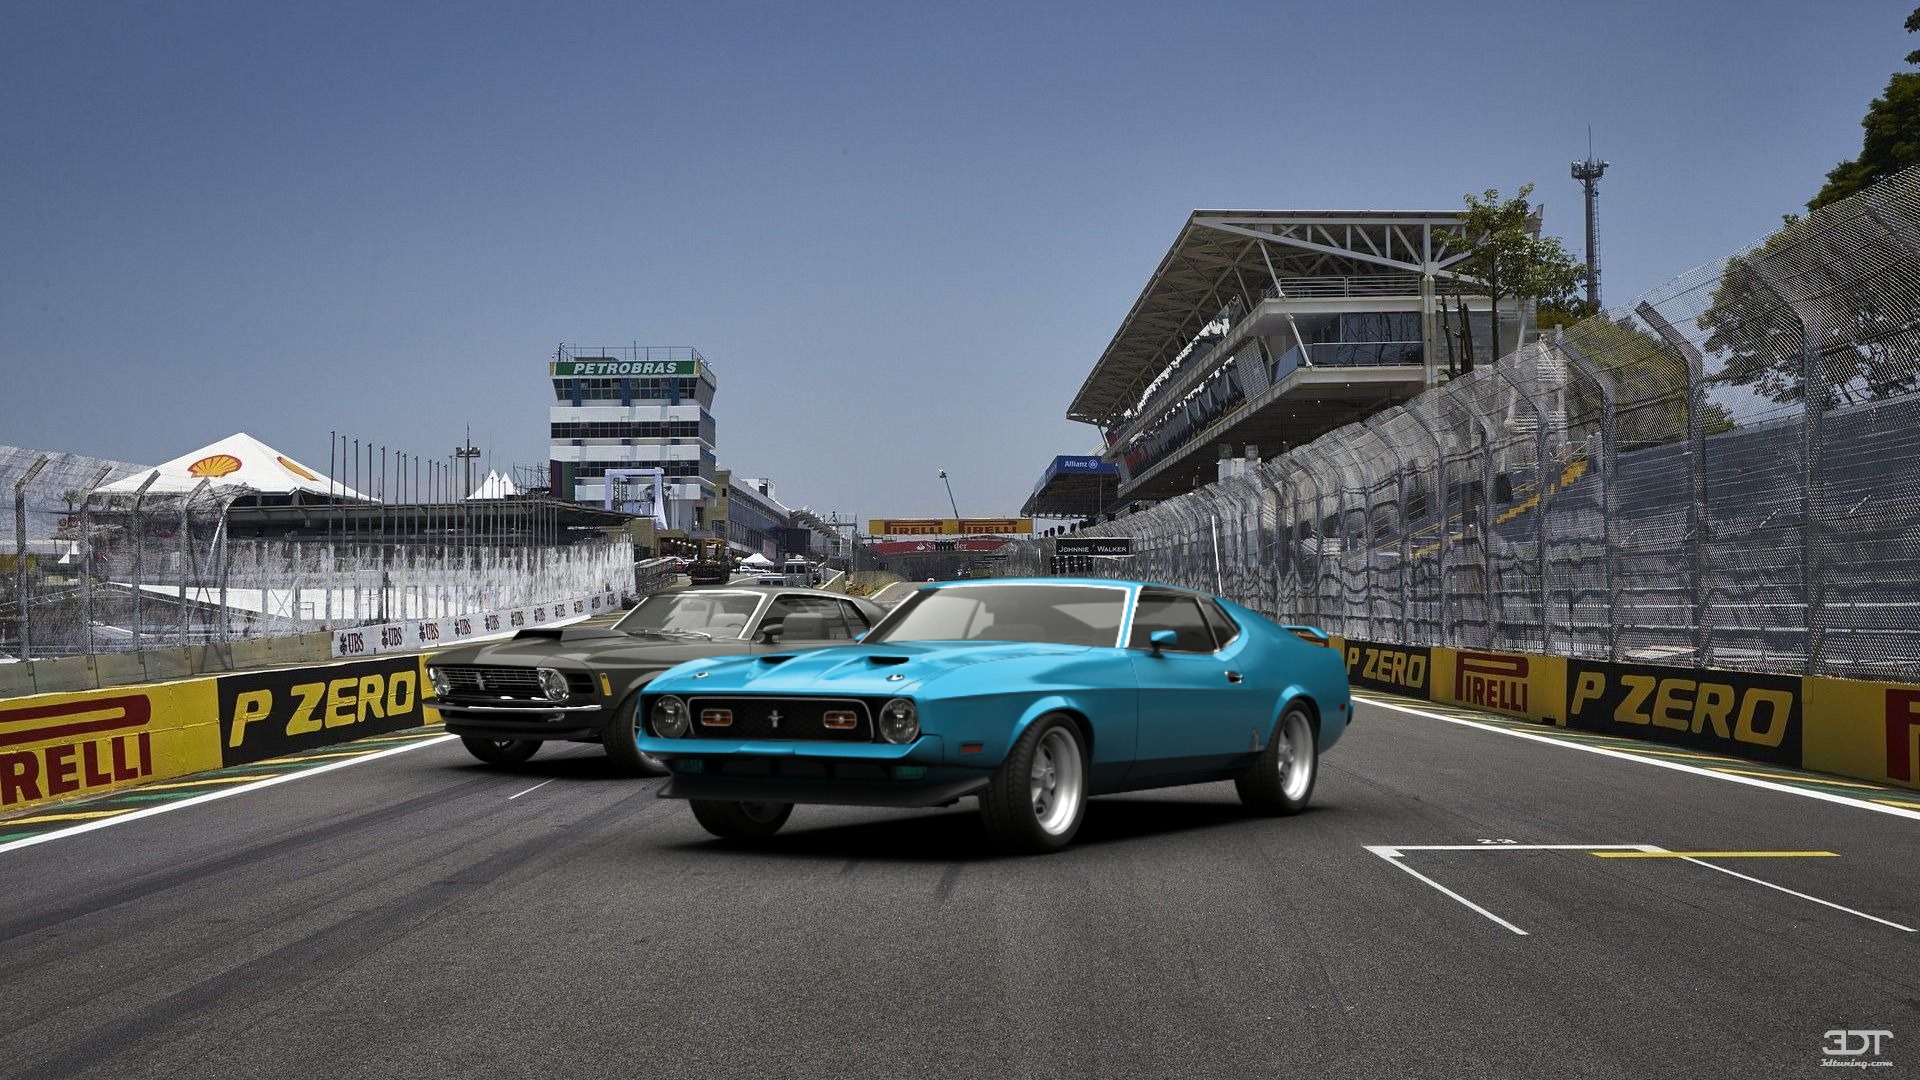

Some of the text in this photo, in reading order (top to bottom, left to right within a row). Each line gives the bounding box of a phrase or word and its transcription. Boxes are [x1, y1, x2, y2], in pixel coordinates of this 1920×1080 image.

[573, 362, 677, 375] PETROBRAS
[1064, 460, 1088, 468] Allianz
[884, 520, 944, 535] PIRELLI
[958, 520, 1018, 534] PIRELLI
[926, 541, 967, 550] Sader
[1059, 545, 1127, 553] JOHNNIE WALKER
[425, 622, 439, 641] UBS
[459, 618, 472, 635] UBS
[347, 632, 364, 653] UBS
[388, 627, 402, 646] UBS
[1347, 647, 1427, 688] P ZERO
[1455, 651, 1530, 713] PIRELLI
[229, 670, 417, 748] P ZERO
[1571, 671, 1793, 747] P ZERO
